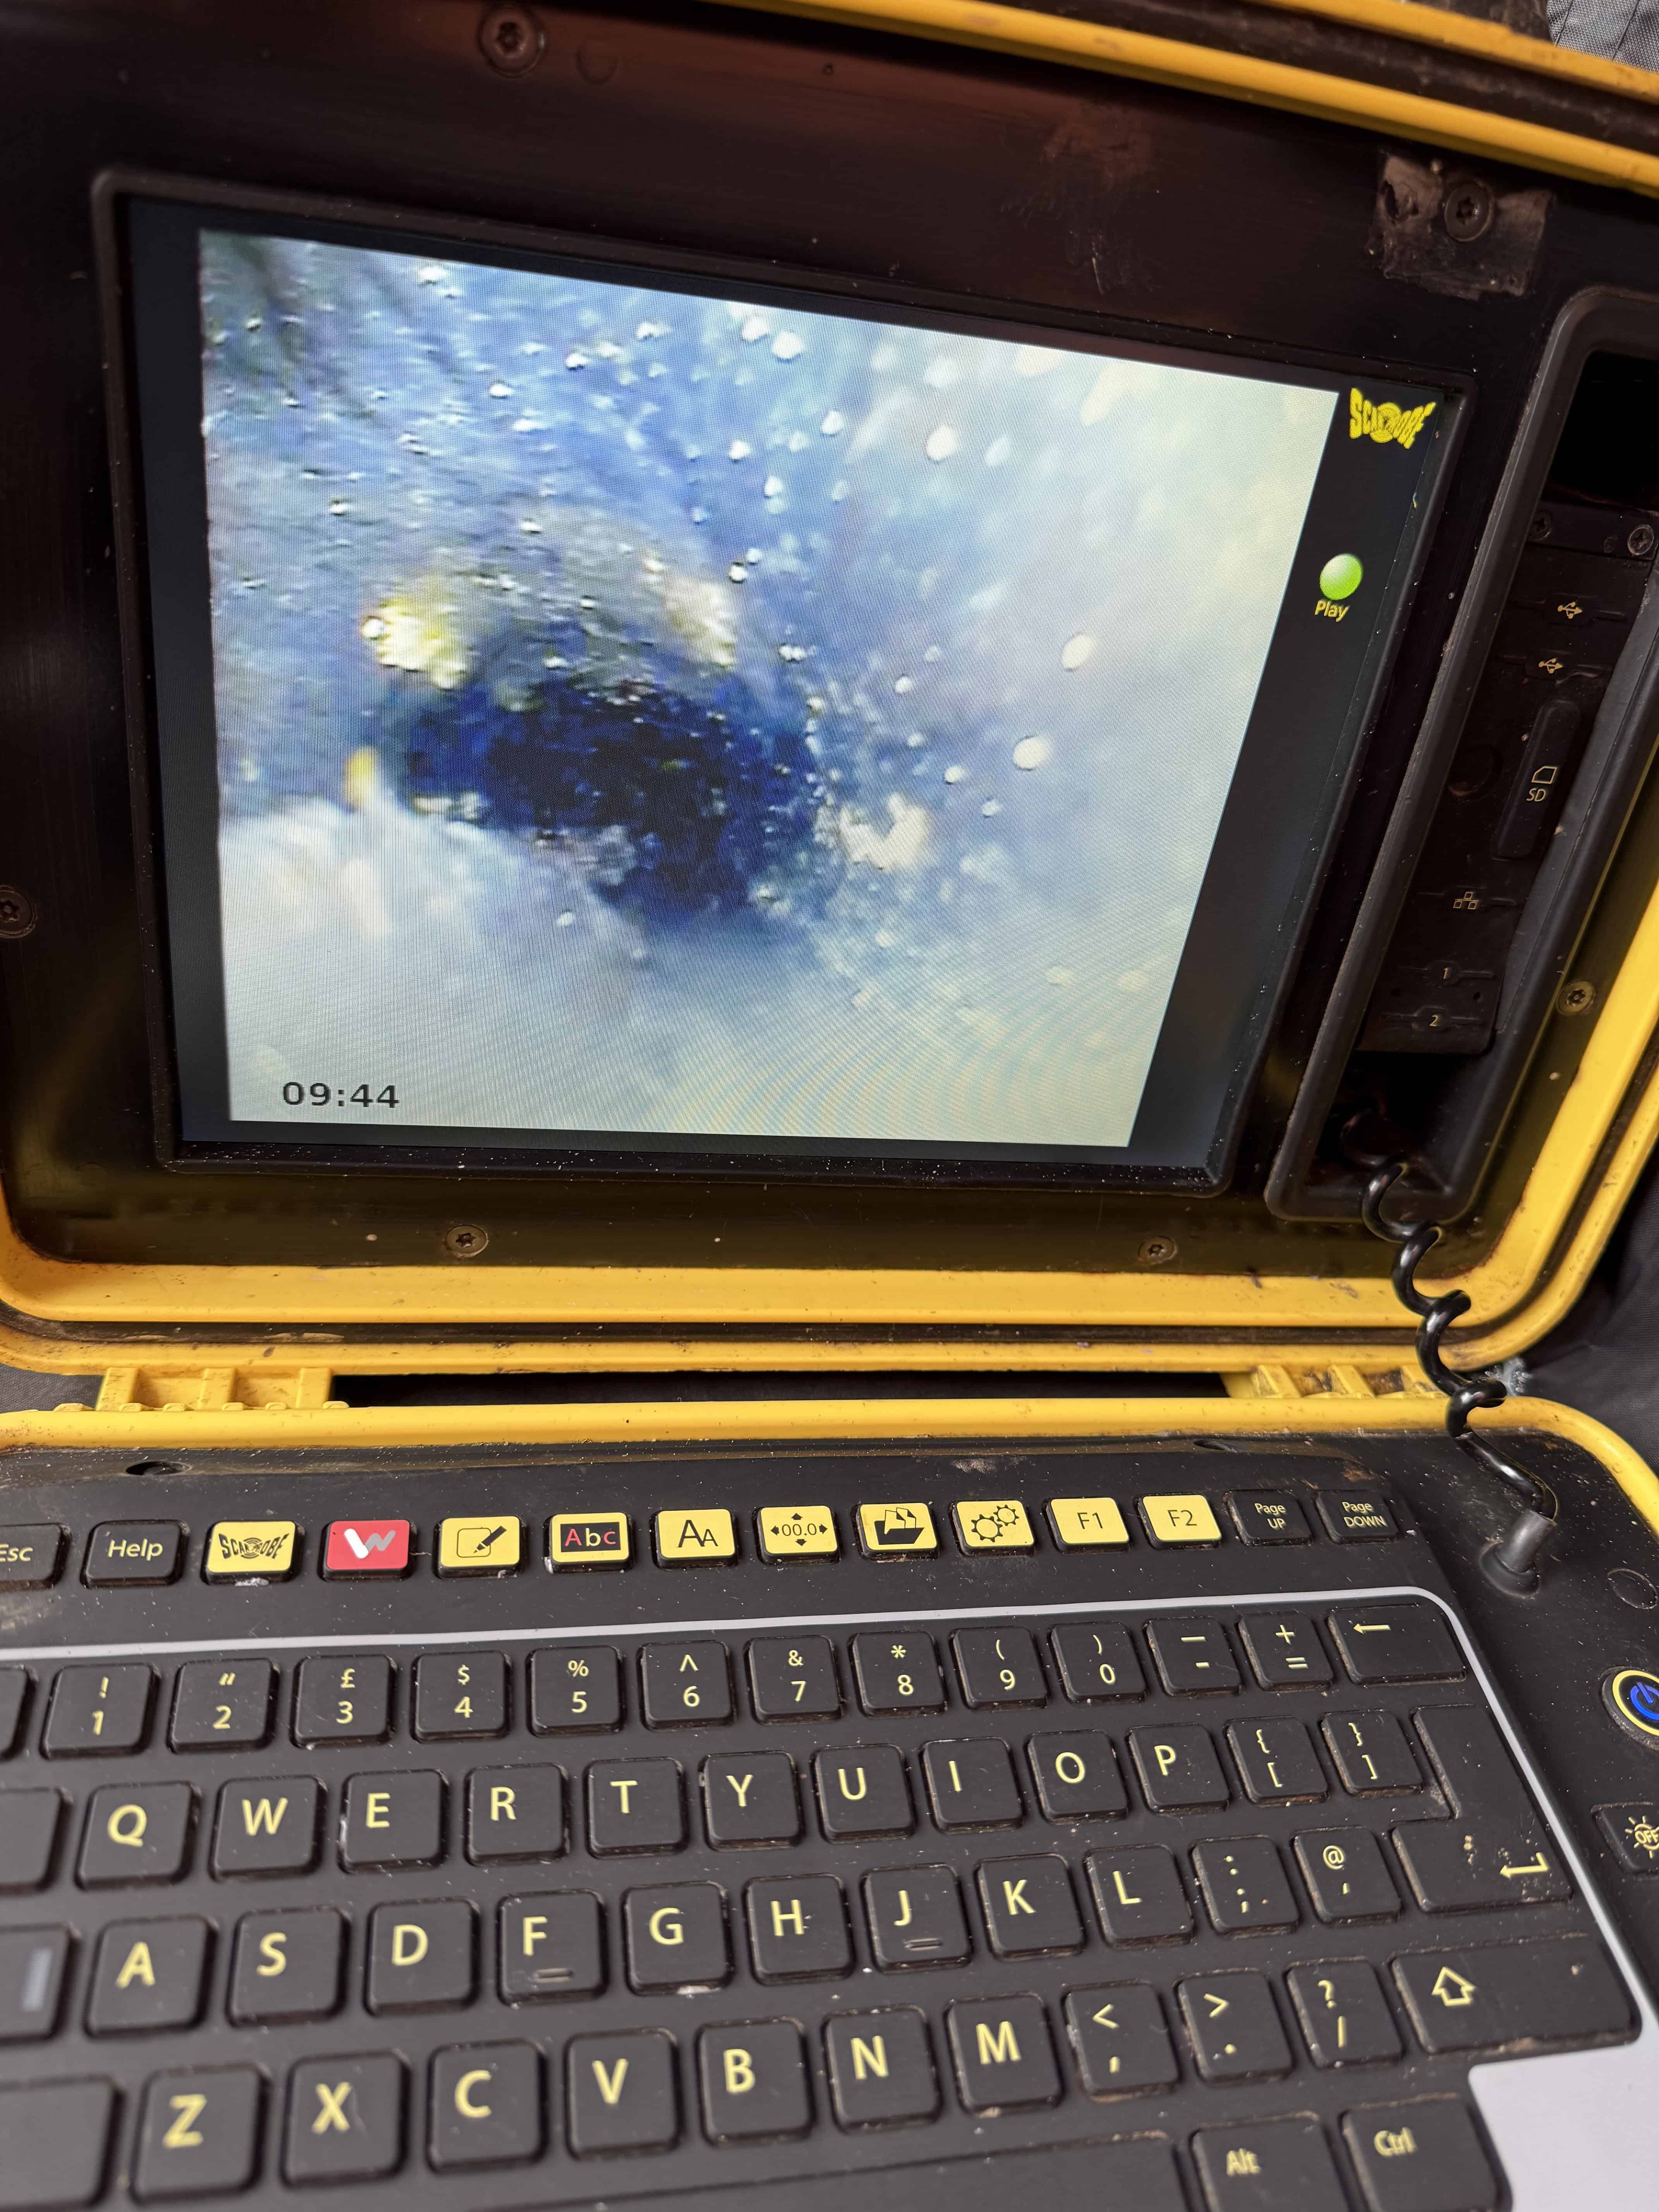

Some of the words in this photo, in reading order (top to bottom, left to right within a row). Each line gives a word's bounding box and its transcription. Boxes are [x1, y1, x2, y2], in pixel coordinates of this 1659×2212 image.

[1315, 599, 1350, 622] Play
[1527, 788, 1546, 802] SD
[1443, 967, 1449, 979] 1
[1429, 1015, 1438, 1027] 2
[283, 1082, 400, 1108] 09:44
[1167, 1508, 1197, 1527] F2
[1255, 1503, 1285, 1515] Page
[1342, 1501, 1372, 1513] Page
[781, 1523, 817, 1536] 00.0
[1077, 1511, 1103, 1530] F1
[1267, 1518, 1285, 1530] UP
[1343, 1515, 1387, 1527] DOWN
[564, 1527, 616, 1547] Abc
[0, 1544, 32, 1562] Esc
[108, 1539, 163, 1560] Help
[1092, 1636, 1102, 1655] )
[1276, 1625, 1293, 1643] +
[788, 1650, 802, 1667] &
[995, 1640, 1004, 1660] (
[568, 1660, 589, 1676] %
[1099, 1664, 1115, 1684] 0
[1285, 1657, 1308, 1669] =
[341, 1669, 354, 1688] £
[458, 1665, 470, 1685] $
[897, 1675, 913, 1695] 8
[1000, 1670, 1015, 1690] 9
[100, 1678, 108, 1698] !
[683, 1686, 700, 1707] 6
[791, 1681, 805, 1702] 7
[338, 1701, 353, 1724] 3
[455, 1697, 472, 1717] 4
[572, 1691, 587, 1713] 5
[93, 1710, 104, 1735] 1
[214, 1705, 231, 1729] 2
[1255, 1729, 1268, 1754] {
[1348, 1722, 1362, 1747] }
[1055, 1753, 1085, 1783] O
[1154, 1745, 1175, 1776] P
[1361, 1755, 1377, 1780] ]
[838, 1768, 866, 1800] U
[948, 1761, 960, 1791] I
[1267, 1762, 1280, 1788] [
[610, 1780, 636, 1813] T
[727, 1774, 752, 1807] Y
[367, 1793, 388, 1827] E
[491, 1787, 515, 1820] R
[109, 1805, 146, 1846] Q
[242, 1798, 287, 1835] W
[1635, 1830, 1659, 1843] OFF
[1225, 1856, 1237, 1875] :
[1322, 1846, 1343, 1869] @
[1003, 1880, 1034, 1915] K
[1113, 1871, 1140, 1905] L
[772, 1899, 803, 1936] H
[895, 1890, 910, 1925] J
[524, 1916, 546, 1955] F
[650, 1908, 682, 1944] G
[258, 1933, 285, 1975] S
[393, 1925, 428, 1965] D
[118, 1942, 154, 1987] A
[1204, 1994, 1227, 2017] >
[1318, 1980, 1334, 2008] ?
[1093, 2004, 1117, 2028] <
[977, 2021, 1018, 2064] M
[852, 2036, 886, 2079] N
[594, 2059, 627, 2104] V
[725, 2049, 753, 2092] B
[456, 2070, 490, 2118] C
[313, 2083, 350, 2132] X
[166, 2095, 205, 2147] Z
[1375, 2129, 1413, 2155] Ctrl
[1228, 2150, 1258, 2173] Alt
